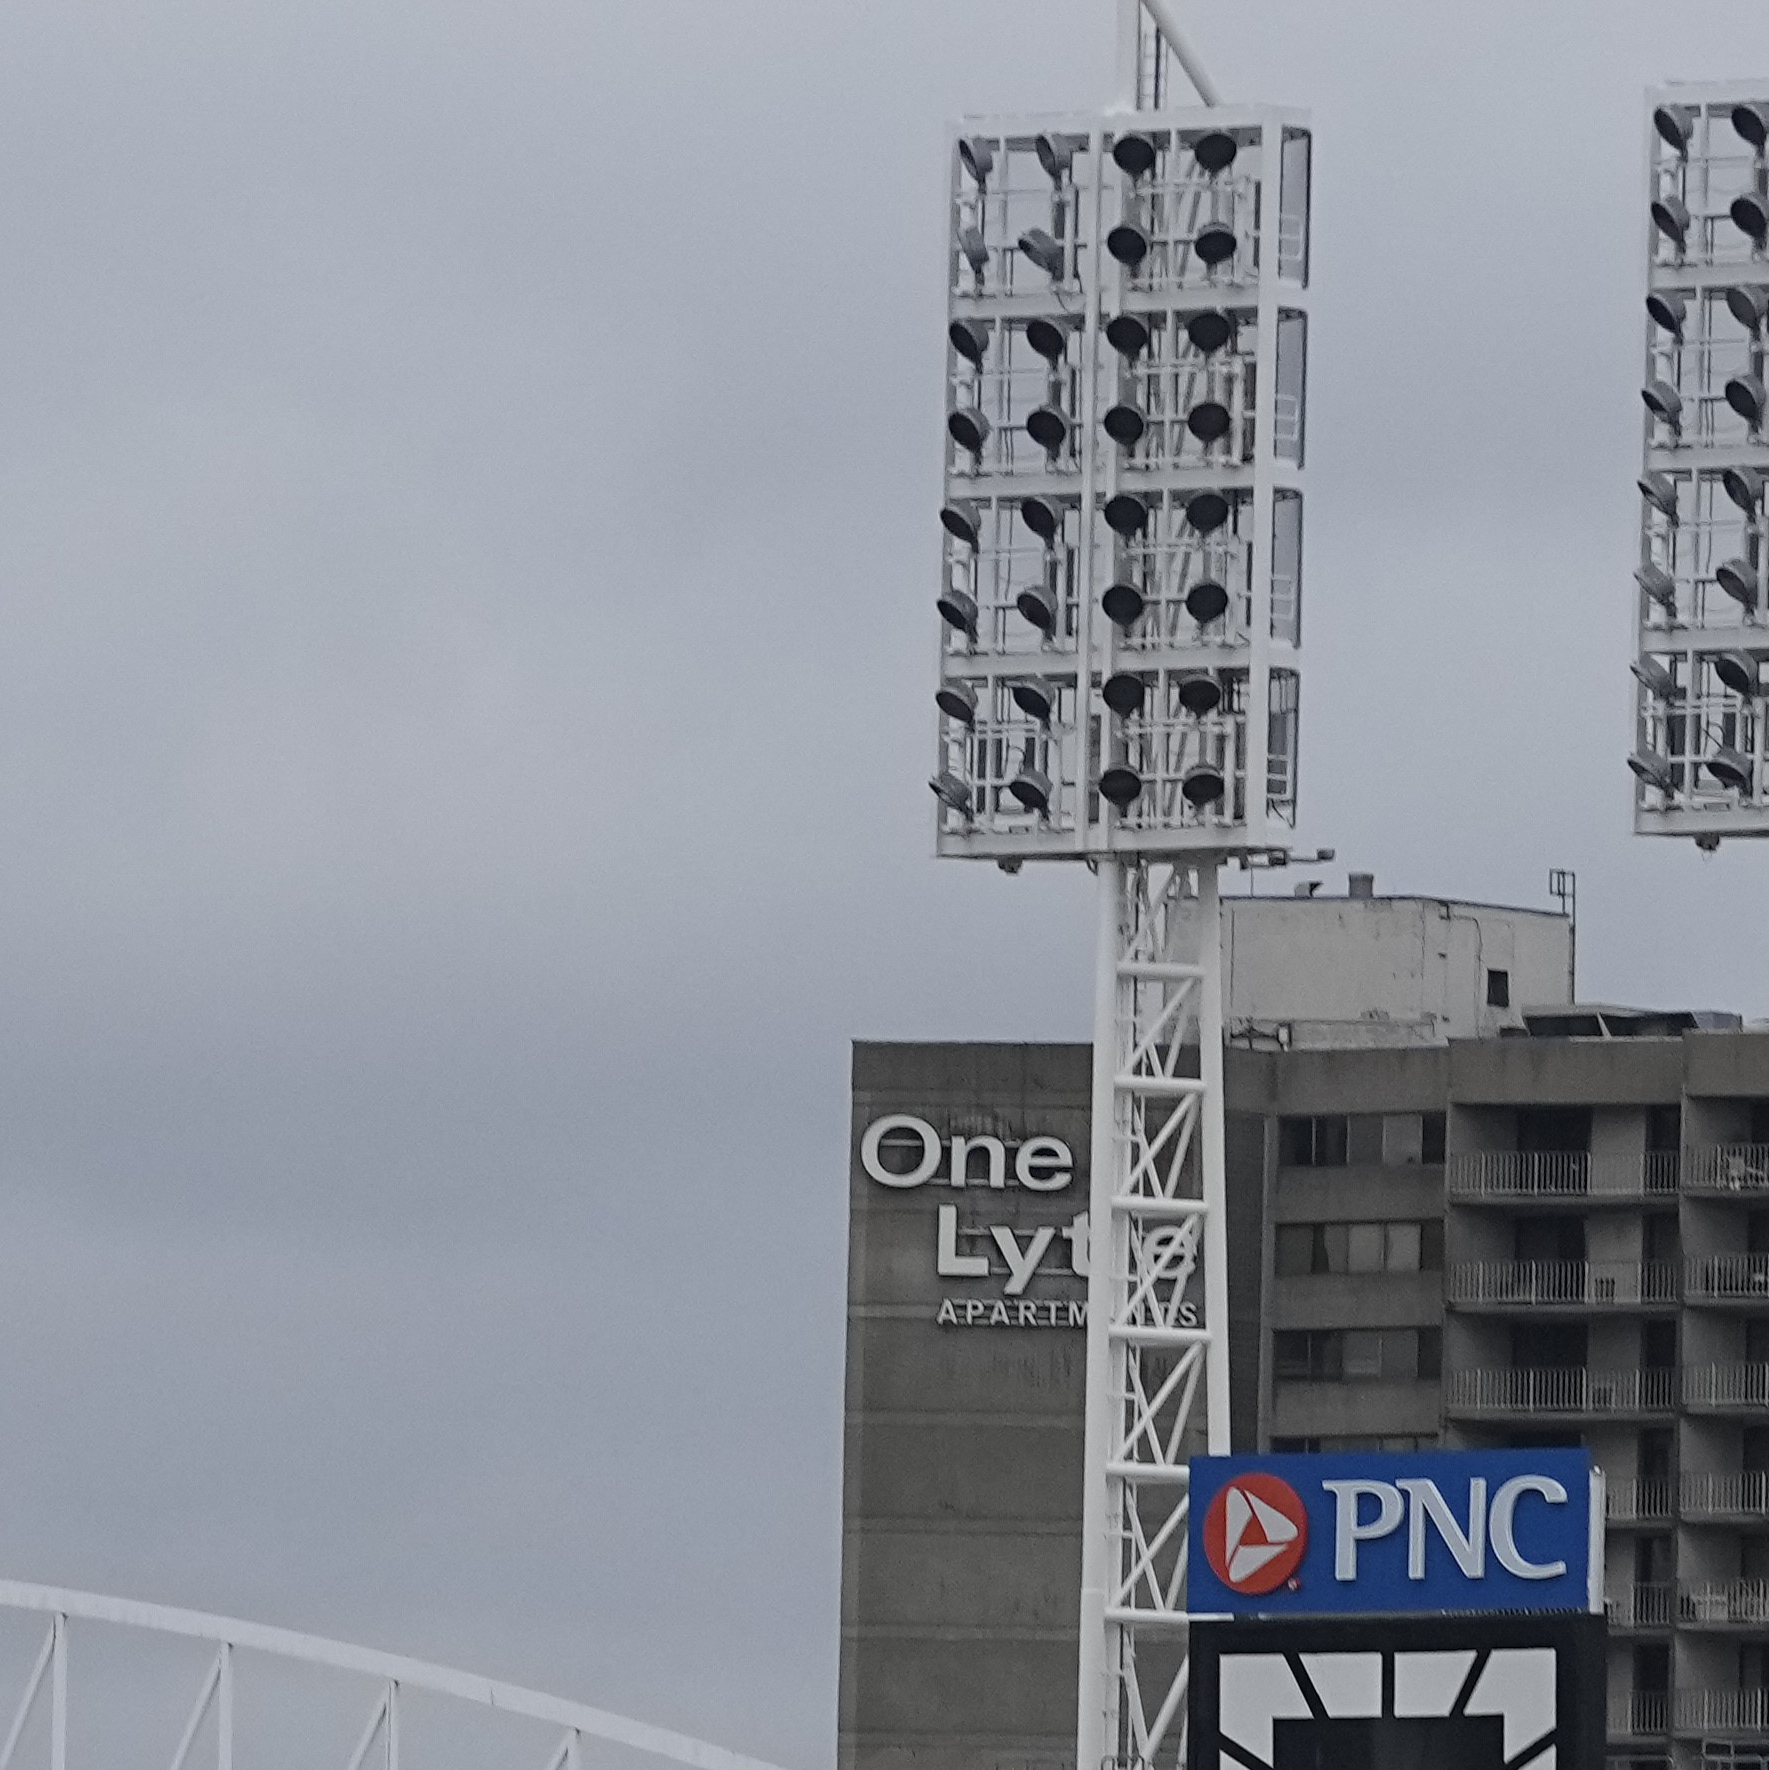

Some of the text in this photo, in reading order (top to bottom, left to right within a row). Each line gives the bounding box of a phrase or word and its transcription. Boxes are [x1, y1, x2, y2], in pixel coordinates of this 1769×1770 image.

[860, 1114, 1073, 1192] One
[937, 1203, 1197, 1296] Lyte
[1322, 1474, 1568, 1581] PNC
